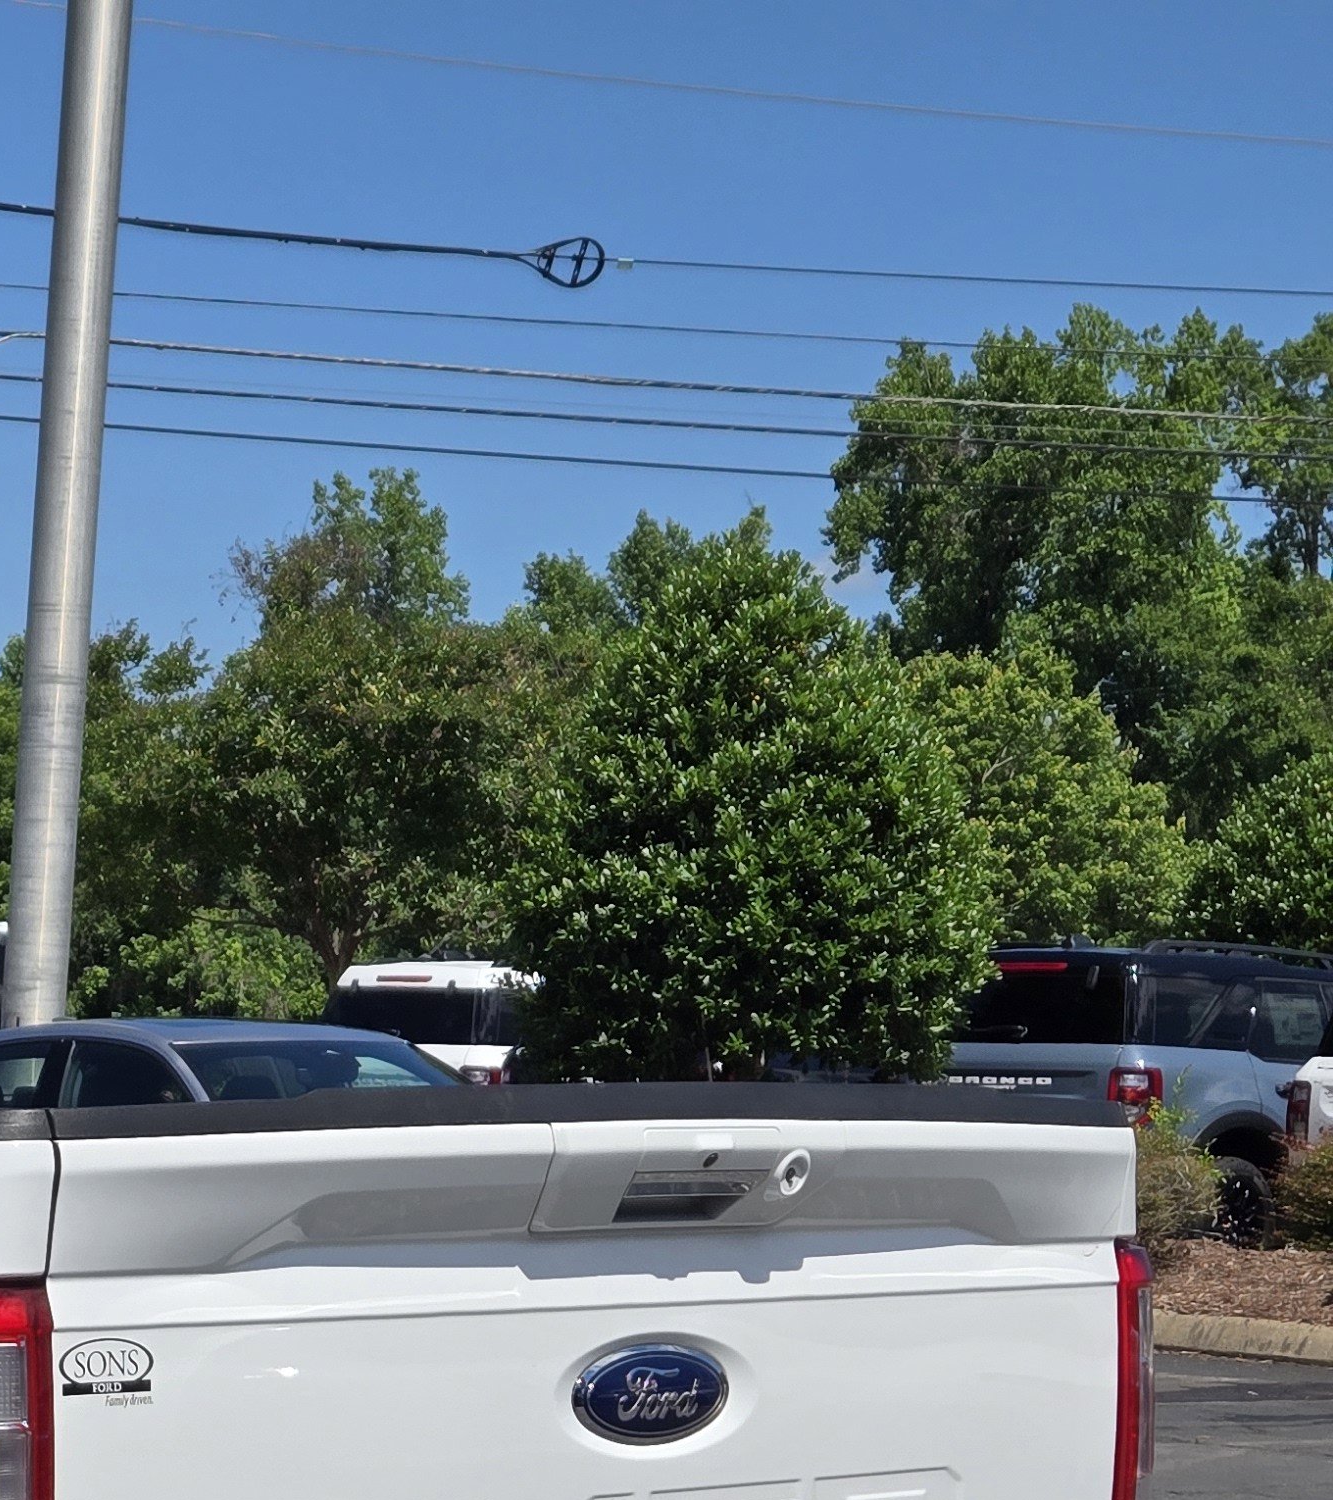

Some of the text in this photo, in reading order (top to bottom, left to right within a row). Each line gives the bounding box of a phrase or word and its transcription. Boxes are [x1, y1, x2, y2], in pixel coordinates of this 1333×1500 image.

[948, 1075, 1052, 1085] BRONCO
[74, 1349, 139, 1378] SONS
[92, 1382, 123, 1393] FORD
[617, 1366, 699, 1422] Ford
